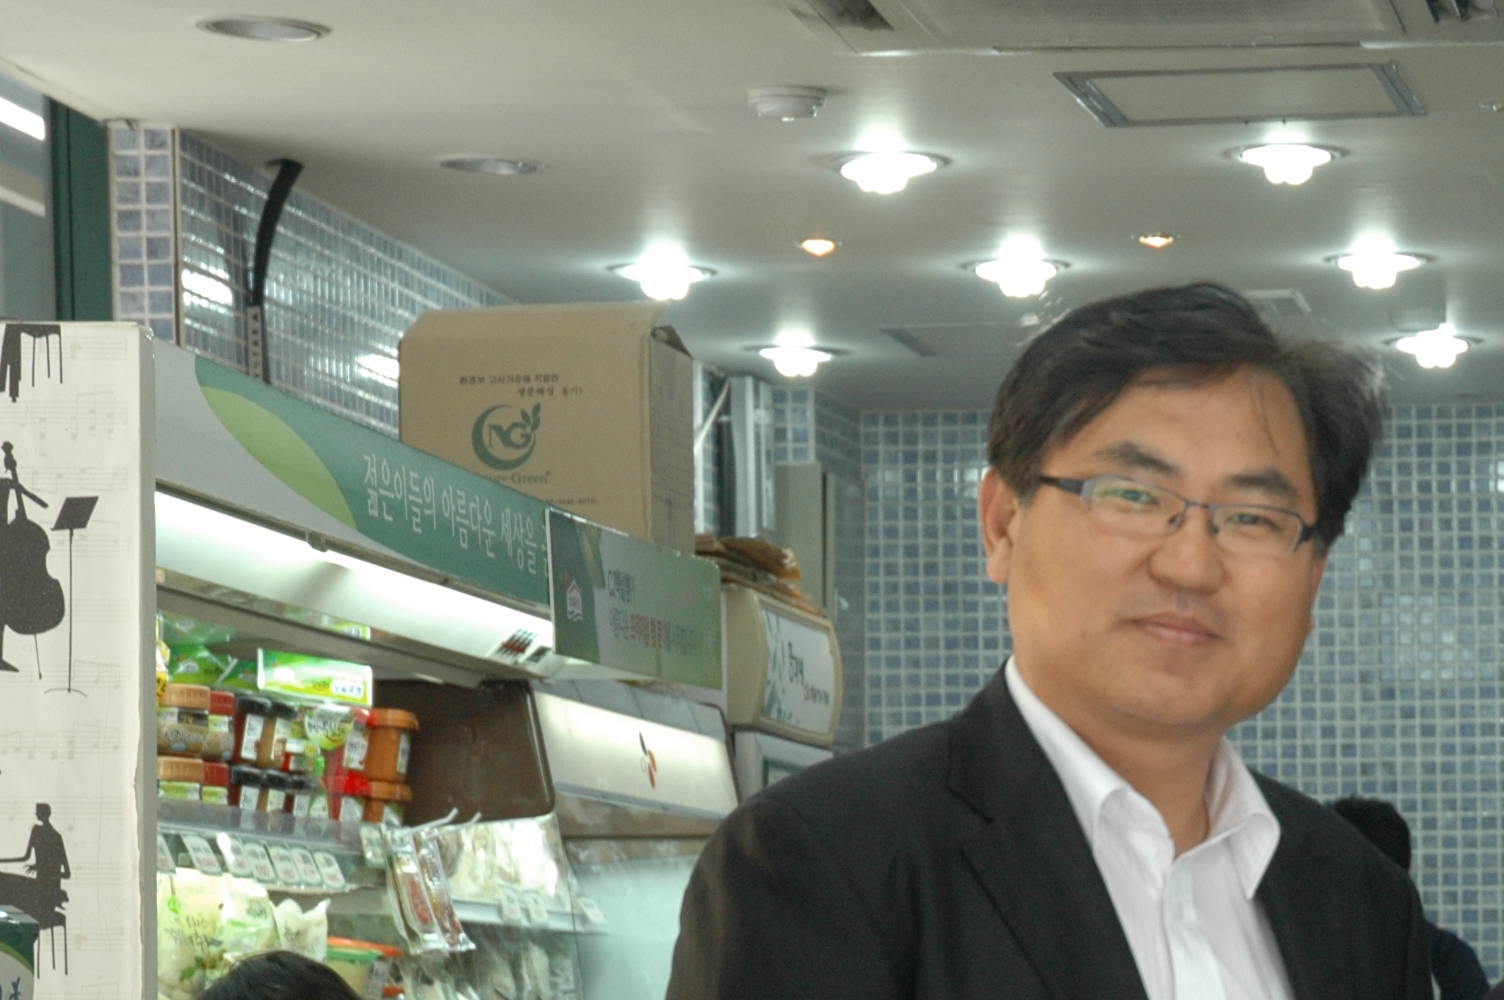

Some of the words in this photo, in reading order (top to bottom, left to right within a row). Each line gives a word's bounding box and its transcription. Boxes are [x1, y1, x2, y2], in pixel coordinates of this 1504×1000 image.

[363, 454, 437, 535] 젊은이들의
[441, 485, 496, 559] 아름다운
[501, 507, 538, 576] 세상을
